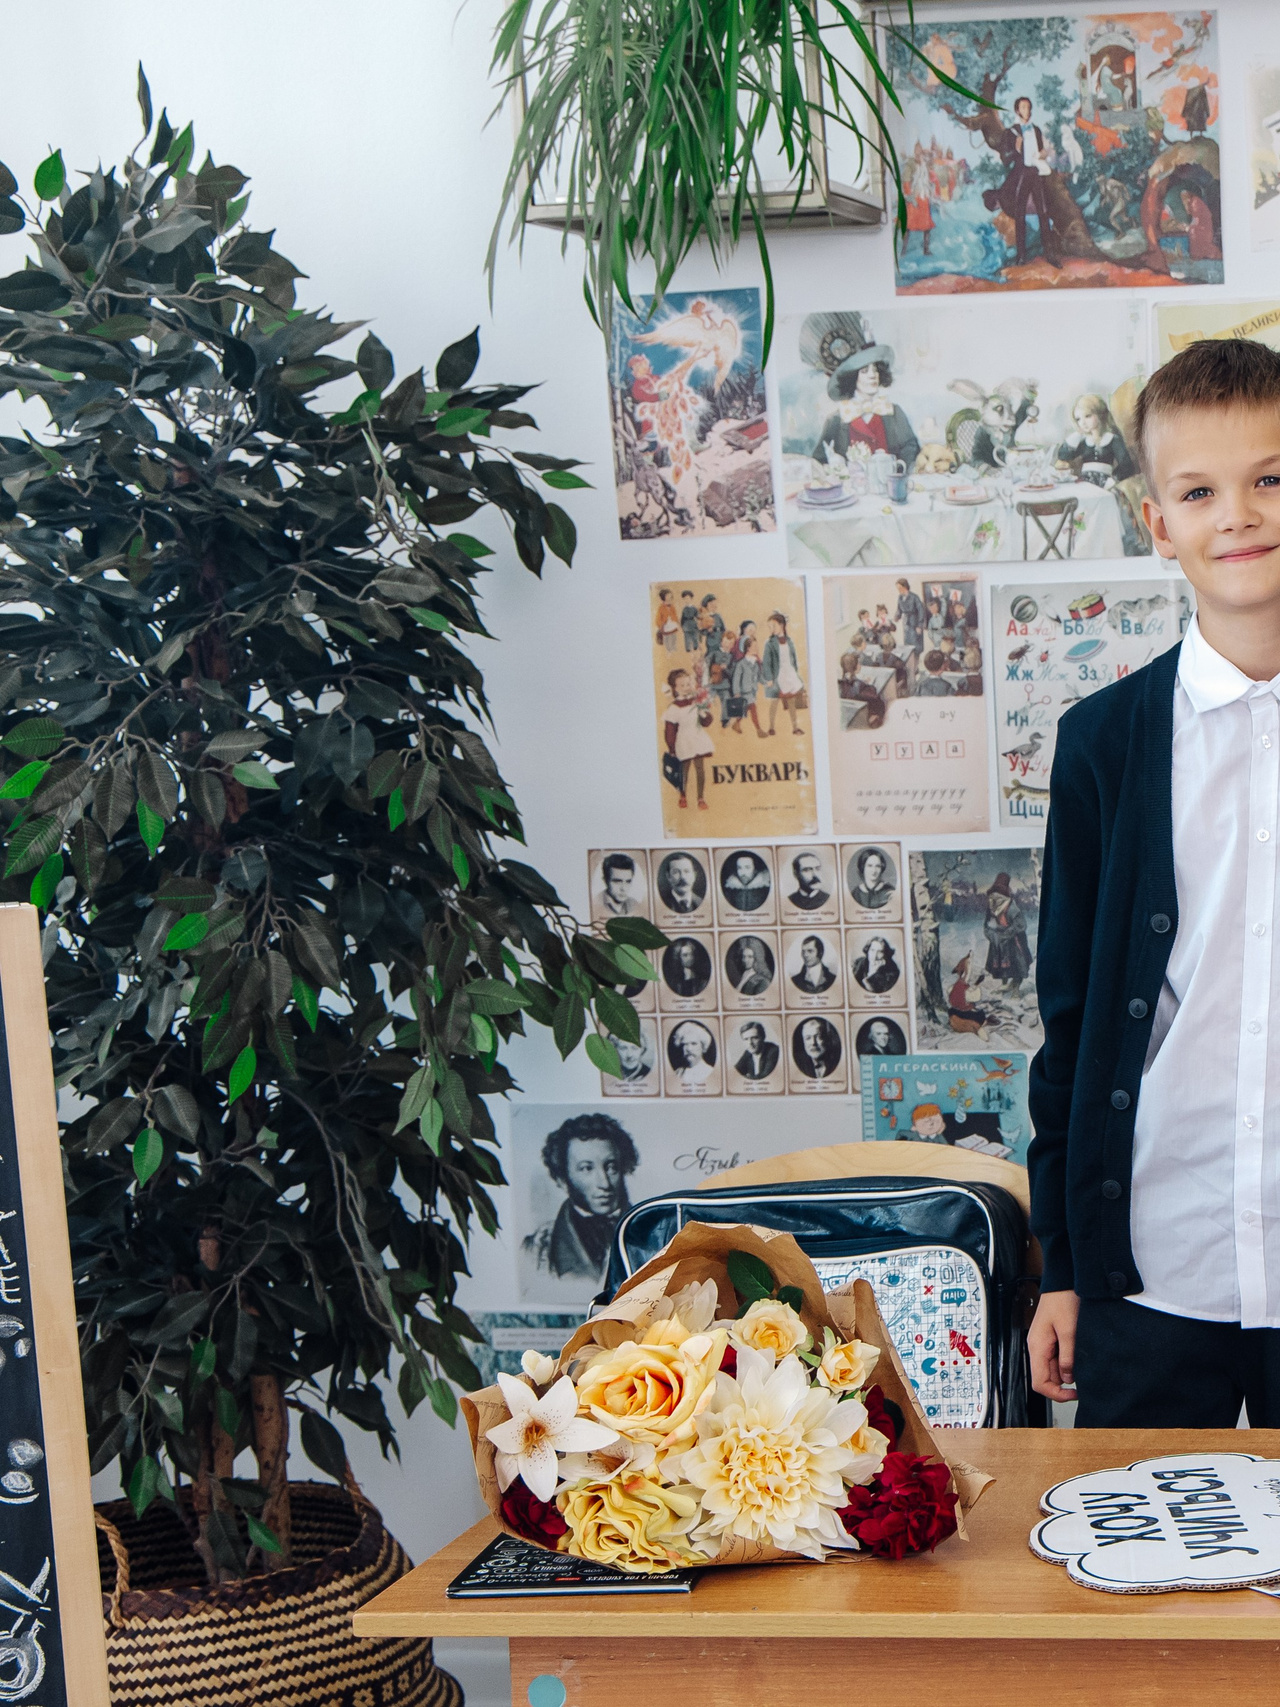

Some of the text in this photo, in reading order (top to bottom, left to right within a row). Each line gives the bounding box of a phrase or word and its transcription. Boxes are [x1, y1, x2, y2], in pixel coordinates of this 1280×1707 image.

[1064, 619, 1084, 636] Бб
[1121, 618, 1144, 635] Вв
[1006, 664, 1034, 682] Жж
[1078, 664, 1097, 681] Зз
[1007, 710, 1029, 727] Нн
[711, 761, 810, 784] БУКВАРЬ
[1008, 754, 1030, 777] Уу
[1009, 800, 1044, 819] Щщ
[894, 1062, 978, 1073] ГЕРАСКИНА
[1079, 1491, 1167, 1547] ХОЧУ
[1151, 1467, 1260, 1560] УЧИТЬСЯ
